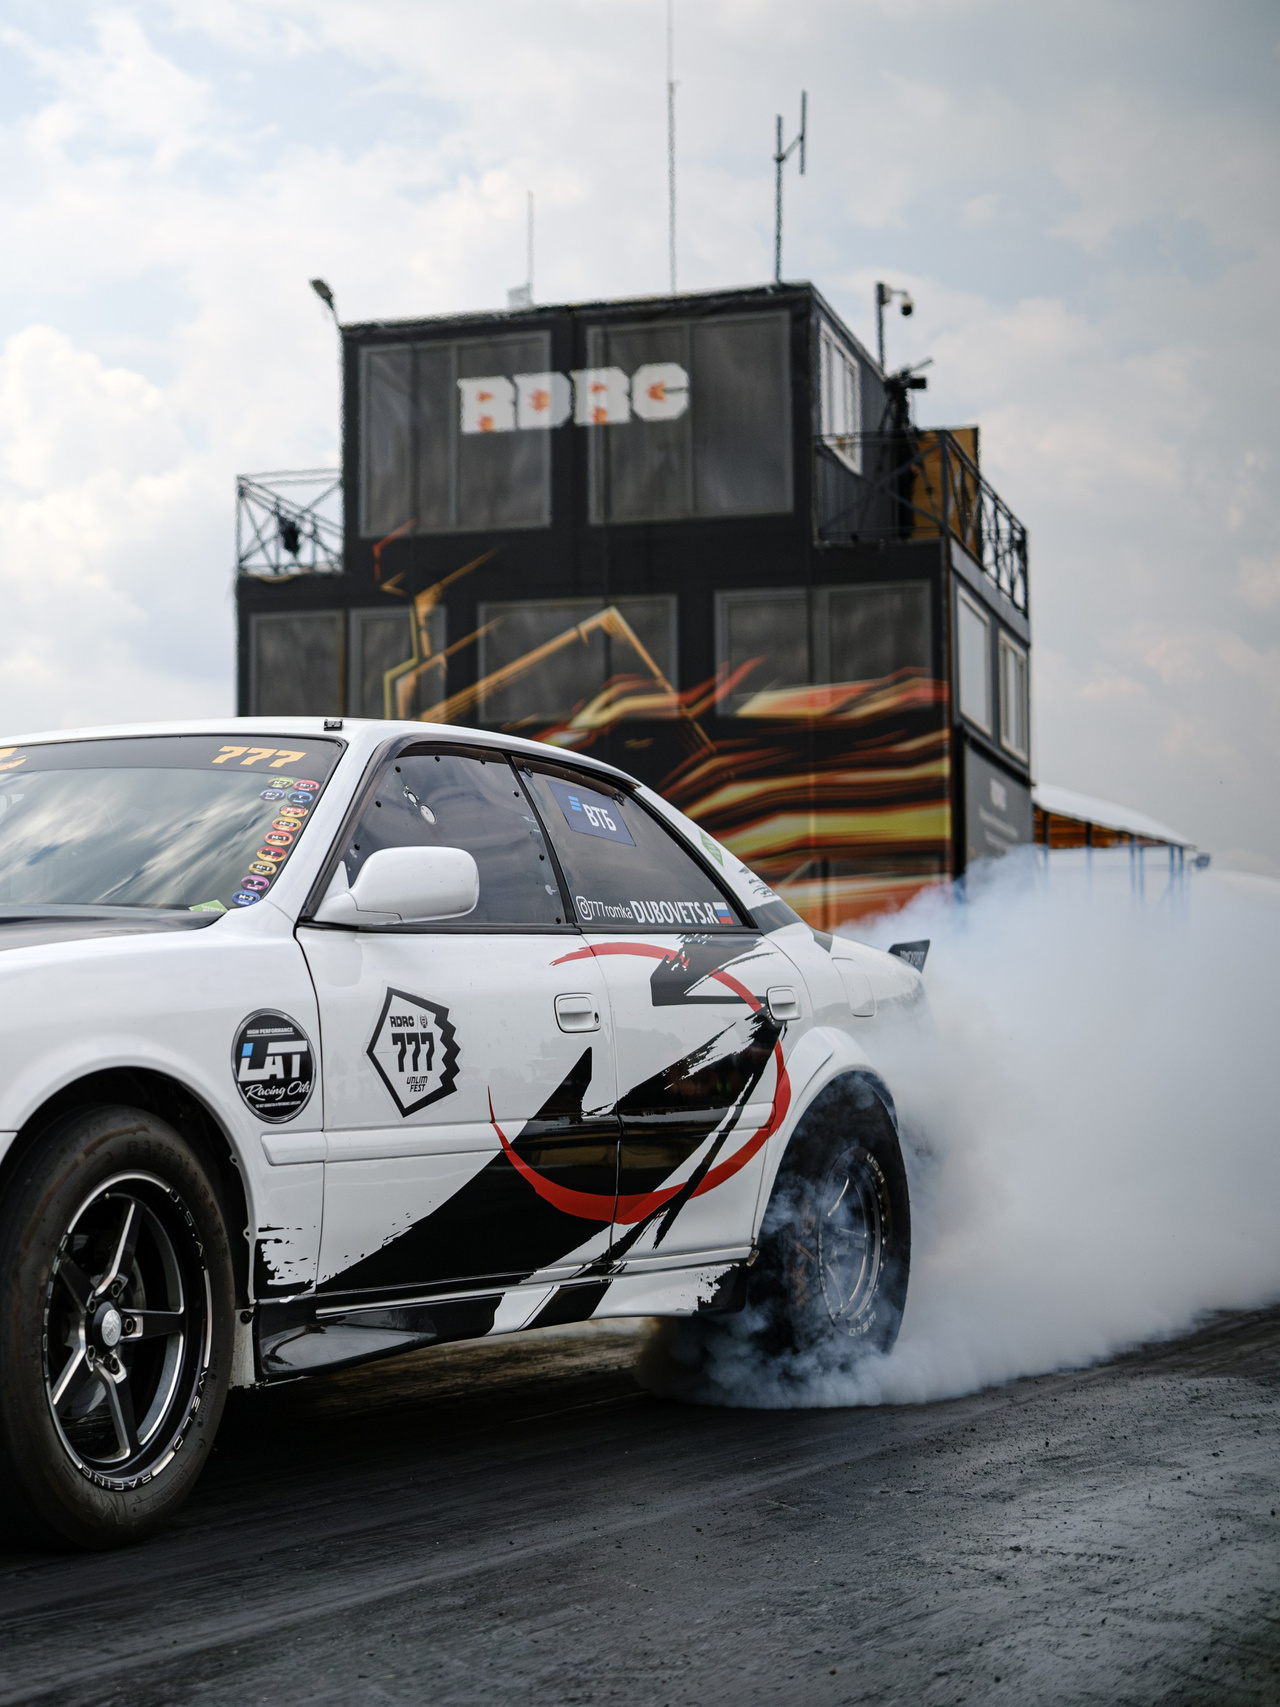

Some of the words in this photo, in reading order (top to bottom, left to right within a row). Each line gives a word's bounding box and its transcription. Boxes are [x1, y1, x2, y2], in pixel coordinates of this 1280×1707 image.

[457, 362, 690, 435] RDRC
[211, 745, 307, 768] 777
[582, 803, 617, 832] ВТБ
[389, 1015, 415, 1028] RDRC
[238, 1040, 308, 1082] LAT
[391, 1032, 435, 1072] 777
[245, 1083, 286, 1101] Racing
[287, 1080, 310, 1096] Oils
[409, 1083, 426, 1092] FEST
[173, 1370, 208, 1451] WELD
[82, 1464, 152, 1491] RACING
